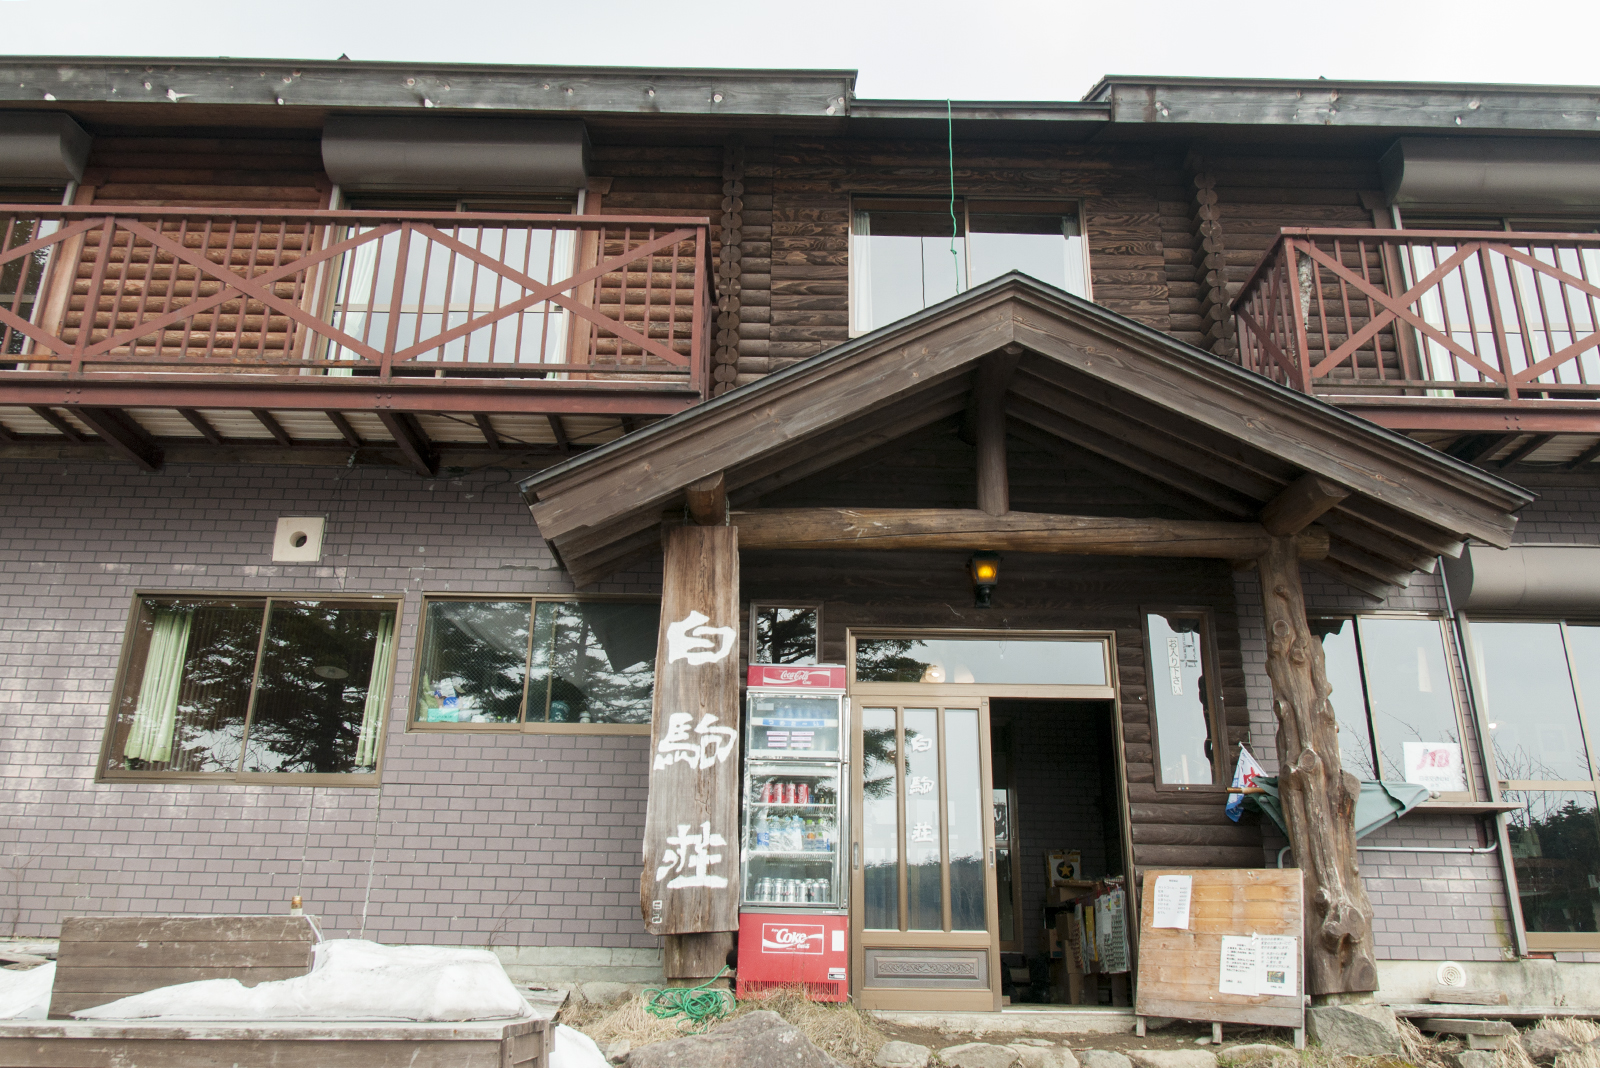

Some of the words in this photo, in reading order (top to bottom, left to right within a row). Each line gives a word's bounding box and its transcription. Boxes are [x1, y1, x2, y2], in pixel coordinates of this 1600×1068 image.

[1168, 638, 1182, 693] お入り下さい
[653, 610, 737, 889] 白駒荘
[1416, 748, 1451, 770] JTB
[908, 733, 935, 842] 白駒荘
[776, 928, 807, 944] Coke
